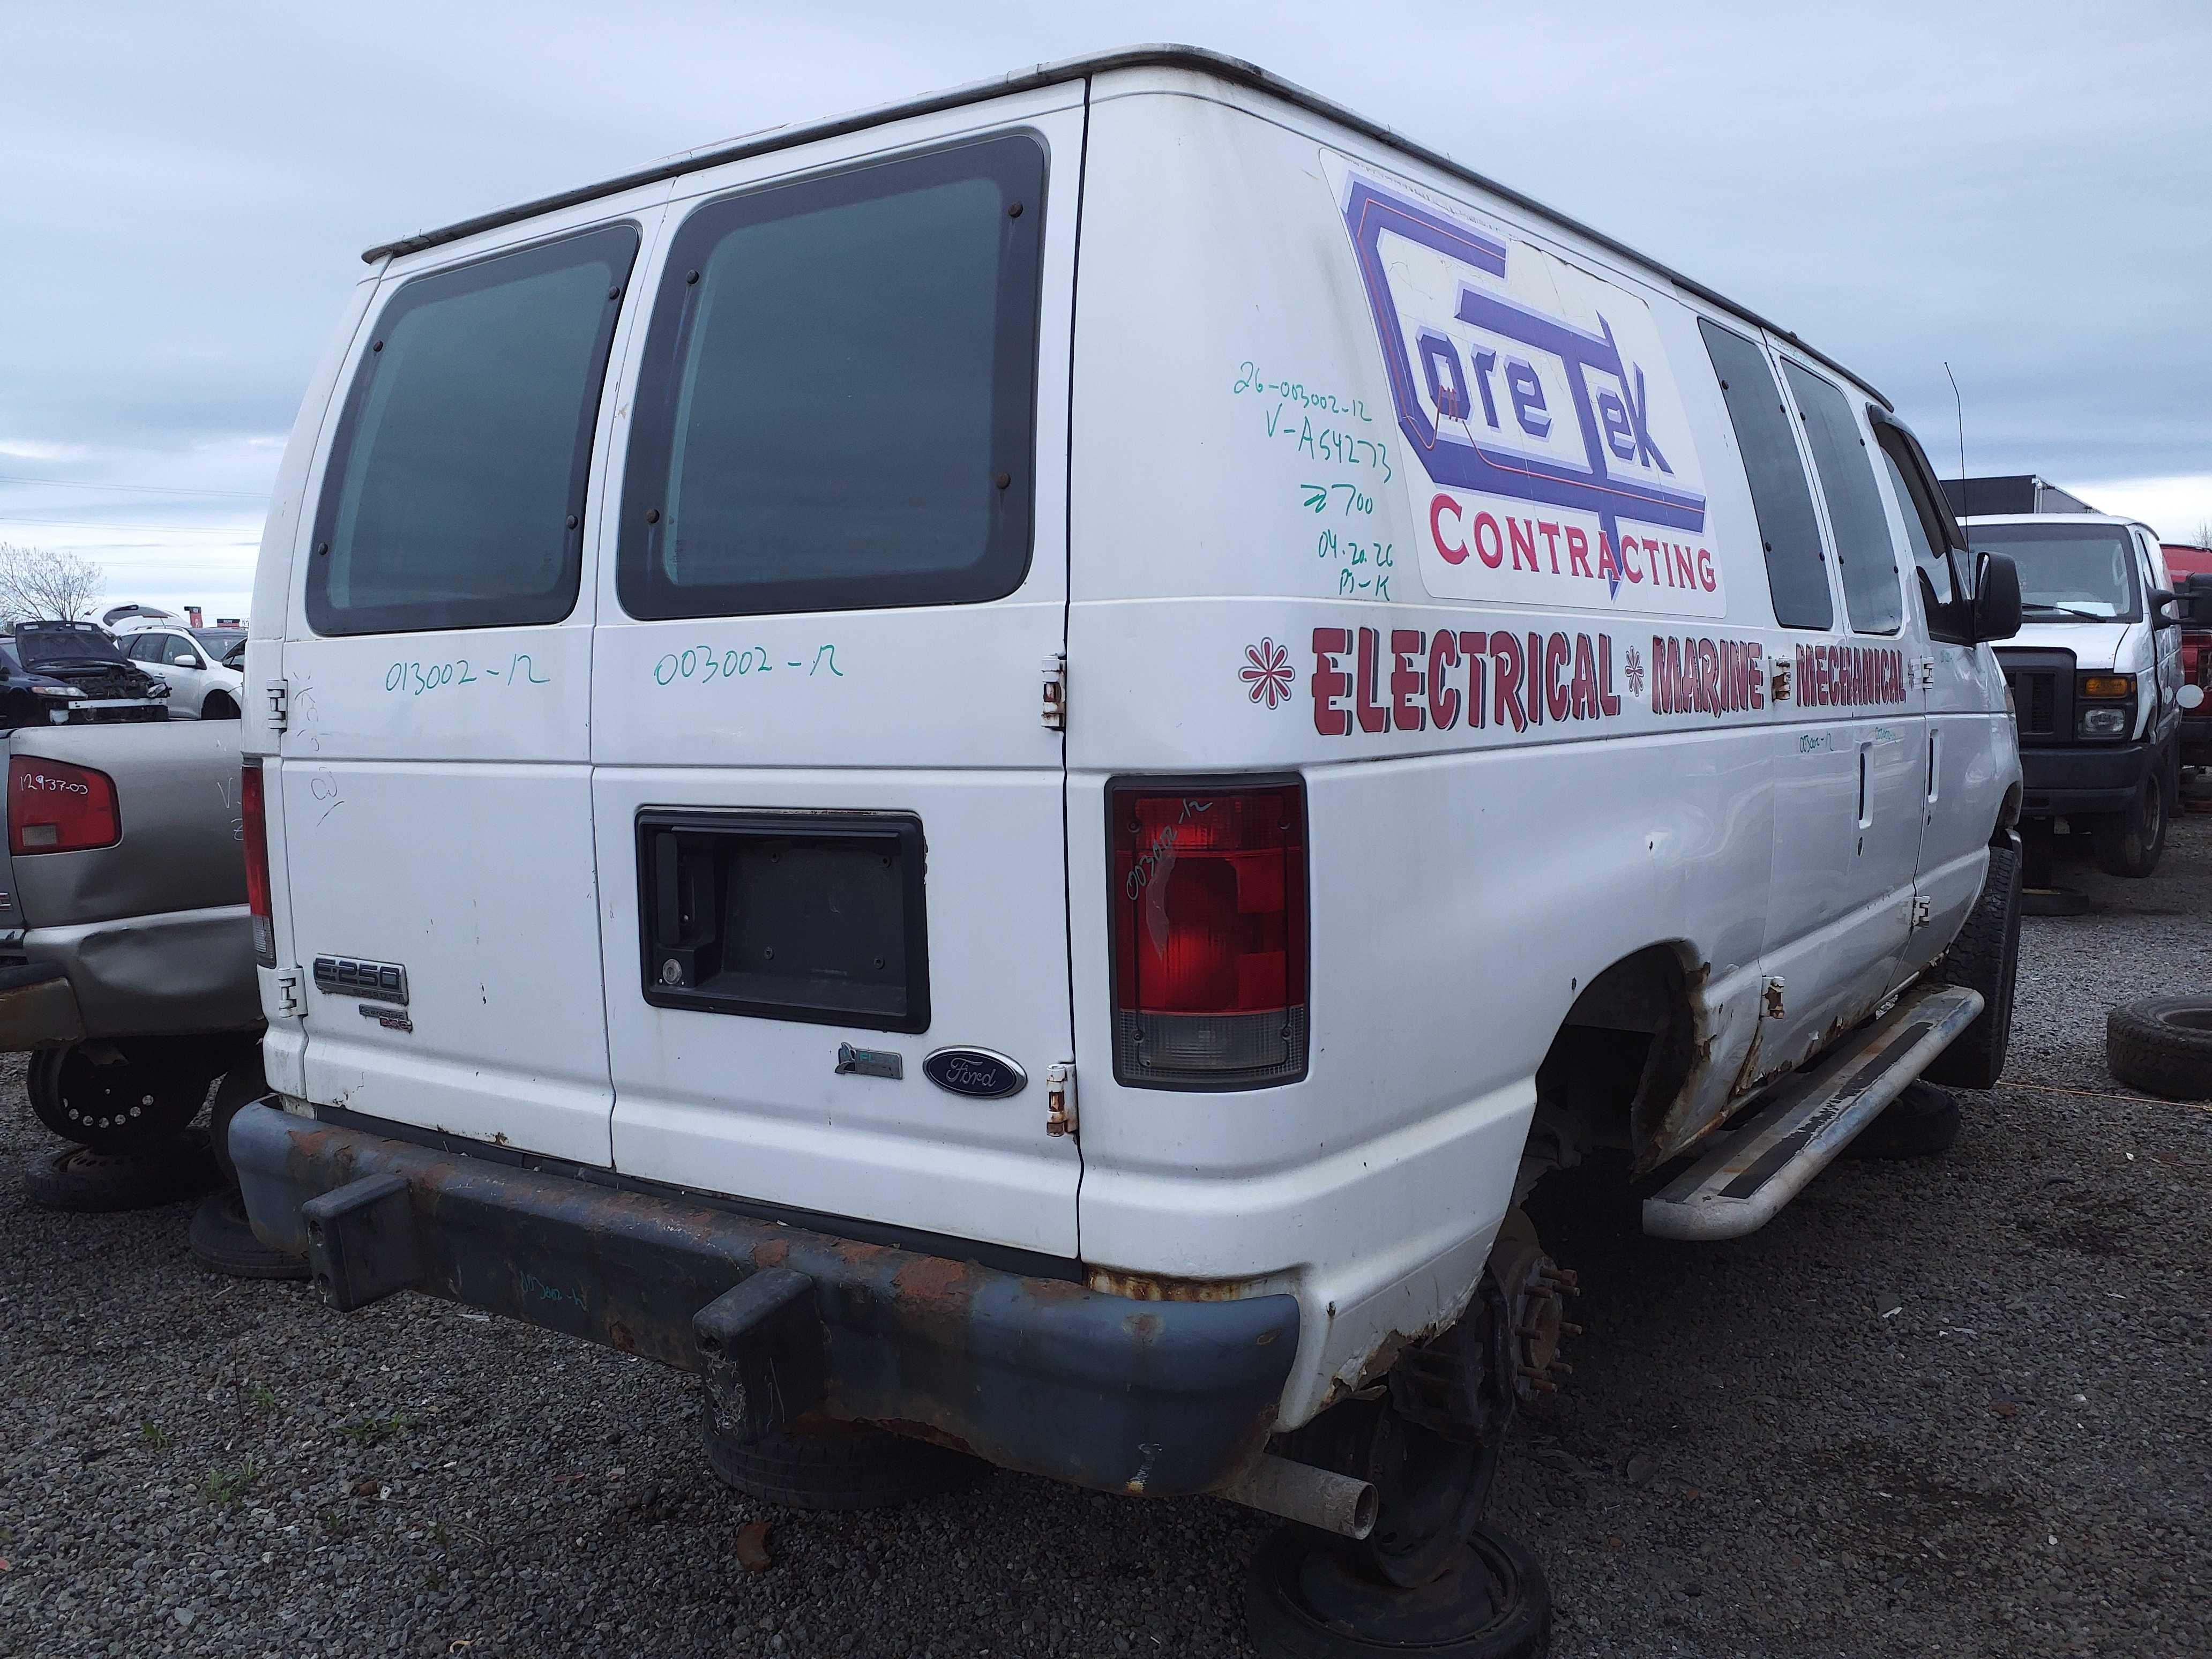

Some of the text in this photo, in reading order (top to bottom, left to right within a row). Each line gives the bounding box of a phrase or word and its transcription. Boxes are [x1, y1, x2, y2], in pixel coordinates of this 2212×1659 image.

[1430, 493, 1716, 593] CONTRACTING
[1312, 627, 1907, 736] ELECTRICAL MARINE MECHANICAL
[945, 1058, 997, 1087] Ford
